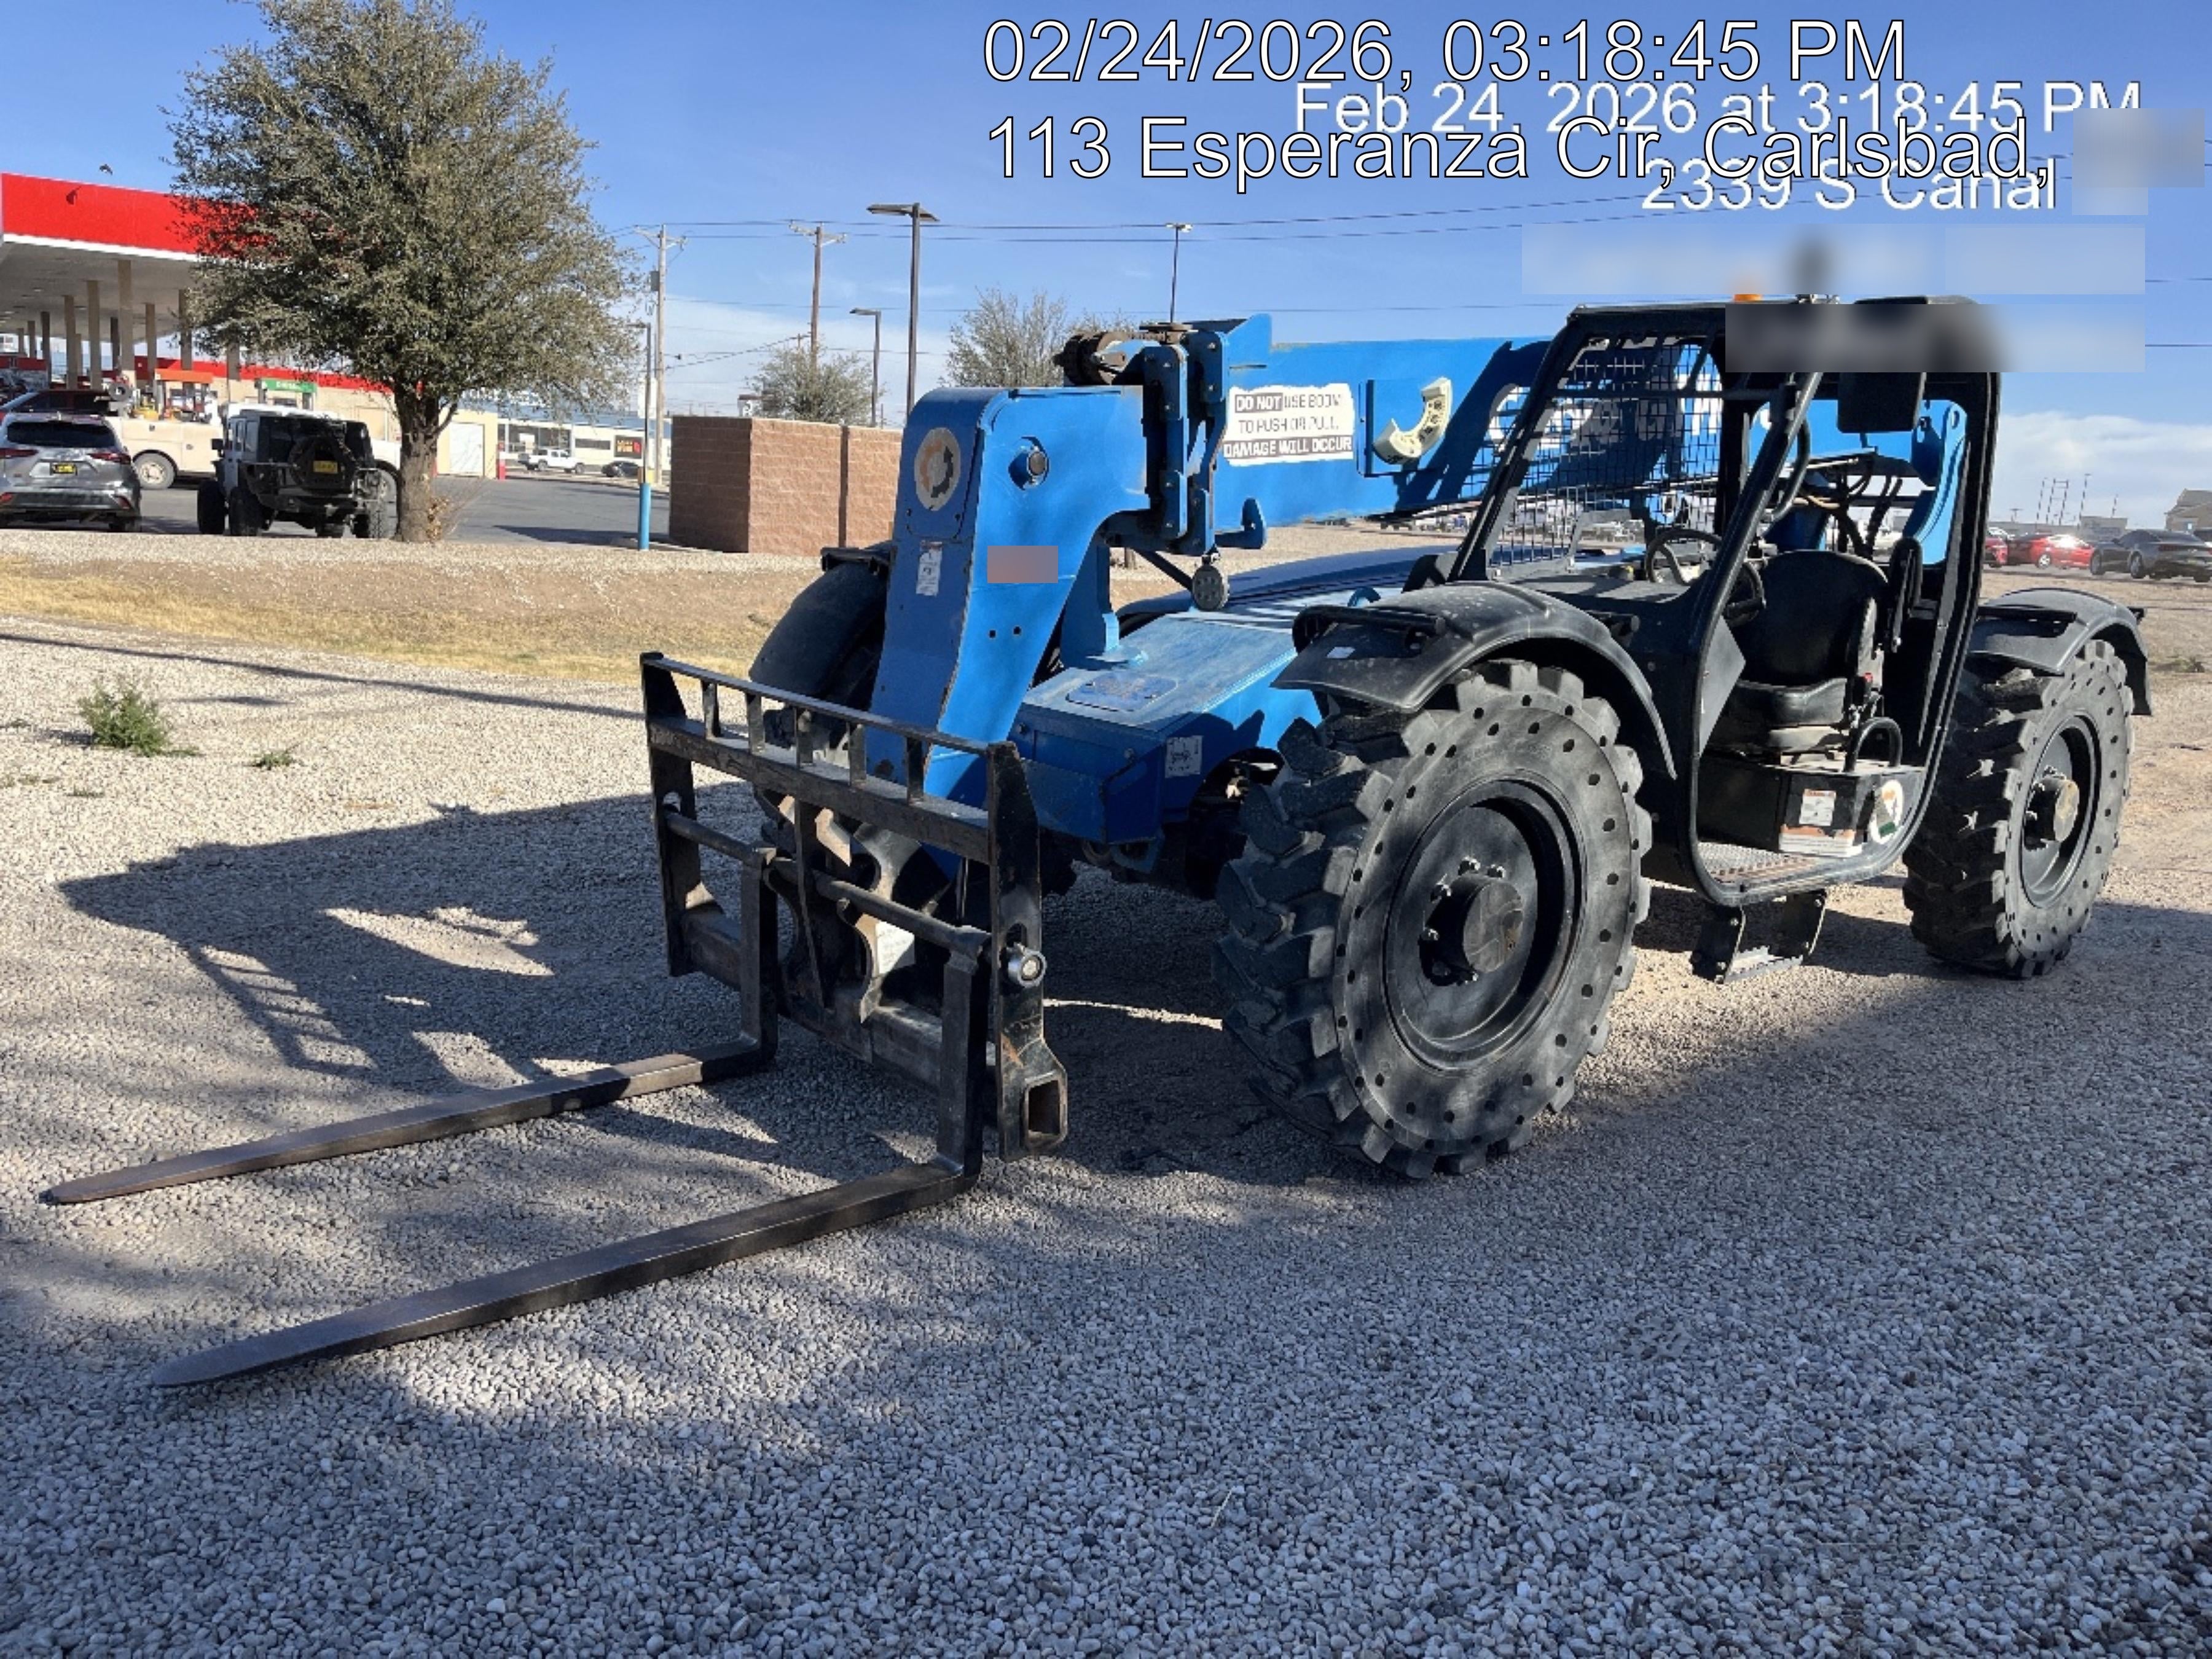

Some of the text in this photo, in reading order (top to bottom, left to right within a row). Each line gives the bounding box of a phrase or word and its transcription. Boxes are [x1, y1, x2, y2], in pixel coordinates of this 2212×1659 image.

[1236, 396, 1254, 411] DO
[1257, 395, 1282, 410] NOT
[1239, 420, 1254, 433] TO
[1257, 418, 1287, 432] PUSH
[1224, 436, 1352, 458] DAMAGE WILL OCCUR
